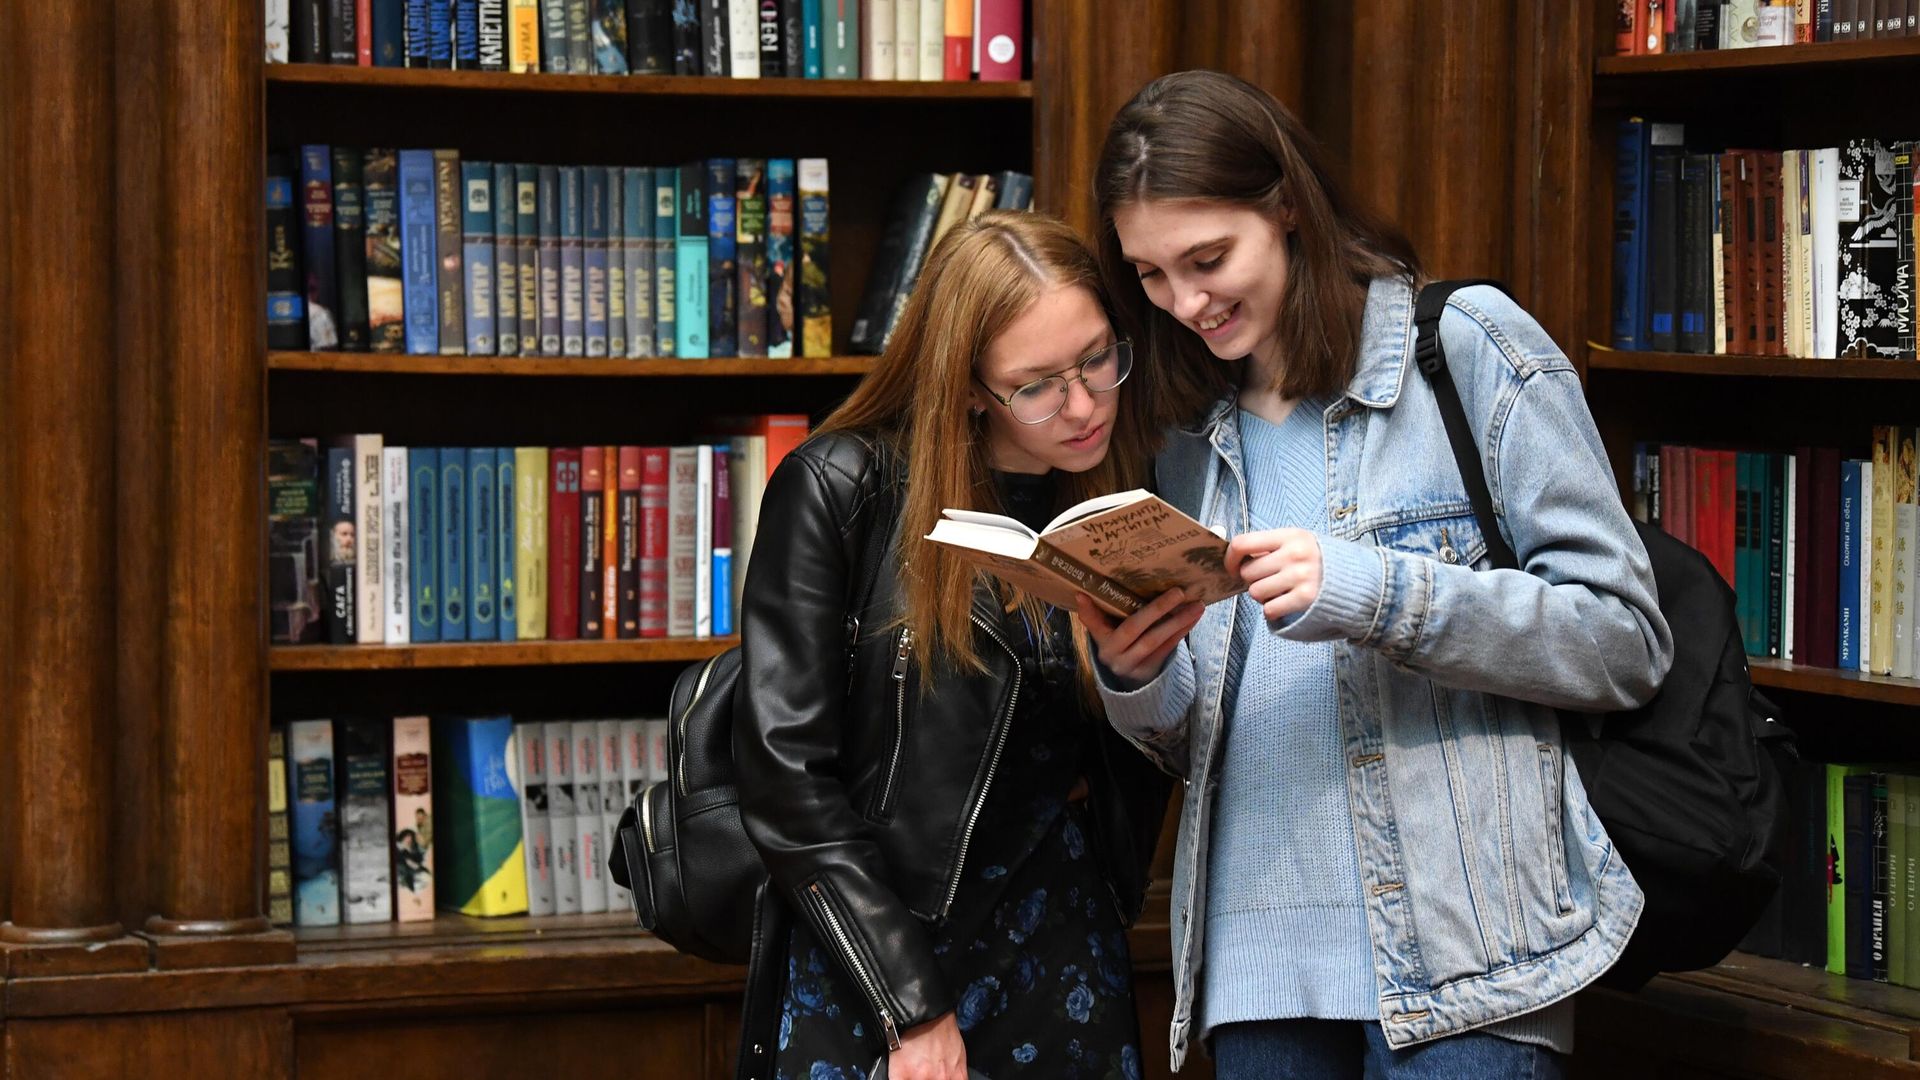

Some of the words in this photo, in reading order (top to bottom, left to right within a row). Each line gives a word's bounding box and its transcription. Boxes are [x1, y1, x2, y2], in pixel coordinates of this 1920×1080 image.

[1896, 264, 1910, 333] МИСИМА
[1843, 535, 1851, 567] Охота
[335, 585, 346, 618] САГА
[1842, 607, 1850, 661] МУРАКАМИ
[1895, 623, 1902, 638] 2
